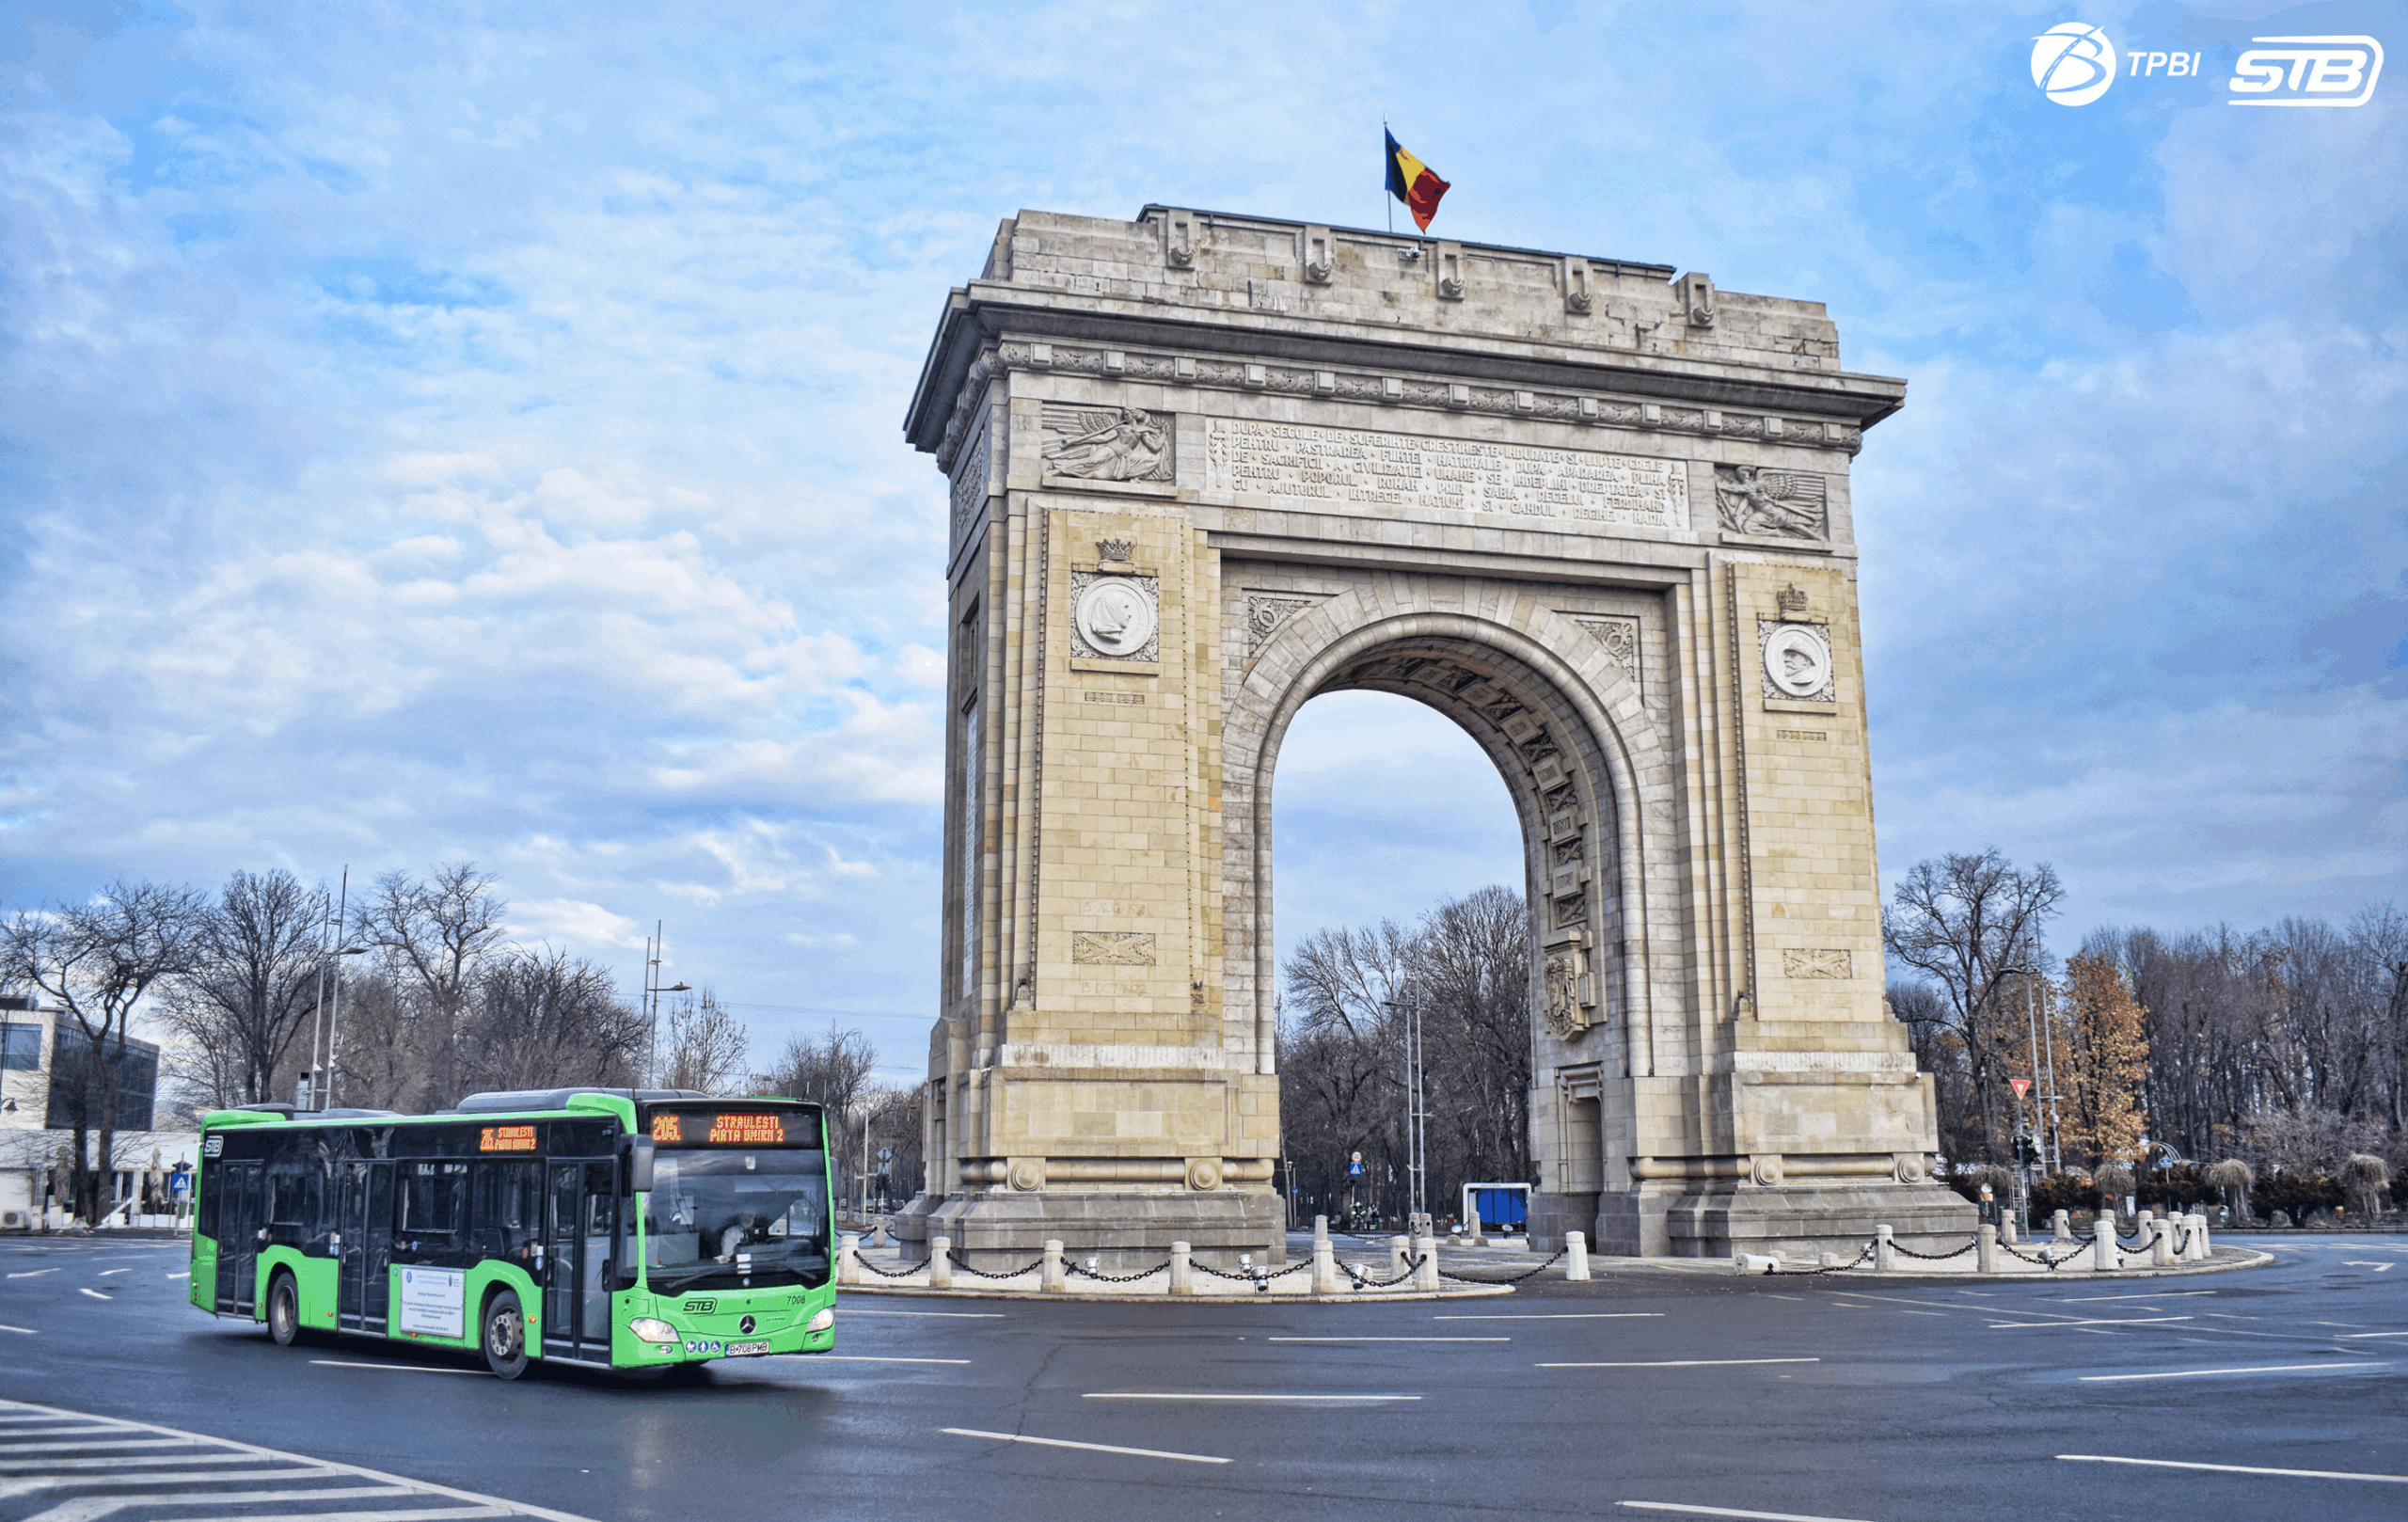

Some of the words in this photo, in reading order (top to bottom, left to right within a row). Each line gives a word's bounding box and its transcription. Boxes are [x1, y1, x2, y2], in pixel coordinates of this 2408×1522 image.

[1232, 421, 1264, 436] DUPA
[1272, 425, 1319, 441] SECOLE
[1325, 431, 1343, 444] DE
[1350, 433, 1416, 451] SUFERINTE
[1421, 439, 1498, 458] CRESTINESTE
[1505, 446, 1560, 464] INDURATE
[1566, 452, 1578, 466] SI
[1585, 453, 1622, 469] LUPTE
[1627, 458, 1664, 473] GRELE
[1232, 436, 1280, 452] PENTRU
[1295, 442, 1368, 460] PASTRAREA
[1436, 454, 1502, 472] NATIONALE
[1514, 462, 1545, 476] DUPA
[1558, 466, 1619, 484] APARAREA
[1232, 451, 1249, 464] DE
[1333, 461, 1343, 472] A
[1486, 473, 1502, 485] SE
[1579, 480, 1644, 499] DREPTATEA
[1655, 488, 1666, 500] SI
[1232, 464, 1280, 481] PENTRU
[1302, 469, 1358, 487] POPORUL
[1377, 476, 1419, 493] ROMAN
[1436, 482, 1465, 497] PRIN
[1483, 486, 1519, 501] SABIA
[1537, 490, 1585, 507] REGELUI
[1604, 497, 1666, 514] FERDINAND
[1232, 479, 1249, 492] CU
[1268, 482, 1334, 499] AJUTORUL
[1481, 499, 1494, 513] SI
[1510, 502, 1558, 518] GANDUL
[1633, 513, 1670, 528] MARIA
[709, 1129, 741, 1143] PIATA
[743, 1129, 774, 1143] UNIRII
[776, 1129, 785, 1143] 2
[716, 1115, 779, 1129] STRAULESTI
[683, 1301, 714, 1311] STB
[786, 1295, 806, 1306] 7008
[729, 1345, 736, 1354] B
[738, 1343, 752, 1354] 708
[752, 1342, 768, 1352] PMB
